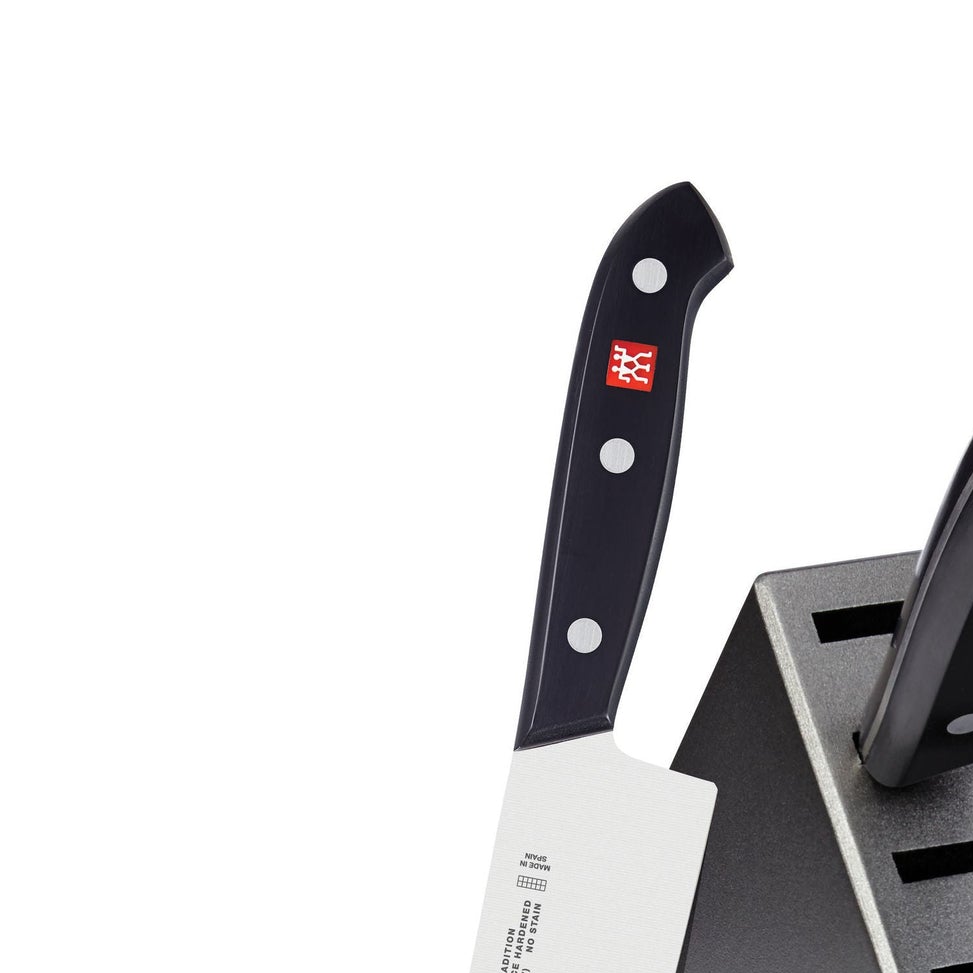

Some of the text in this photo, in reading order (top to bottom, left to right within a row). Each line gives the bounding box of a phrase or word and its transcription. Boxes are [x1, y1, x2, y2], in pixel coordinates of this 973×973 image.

[524, 852, 548, 863] SPAIN
[519, 860, 551, 872] MADE IN
[529, 903, 542, 935] STAIN
[513, 900, 532, 959] HARDENED
[525, 938, 535, 953] NO
